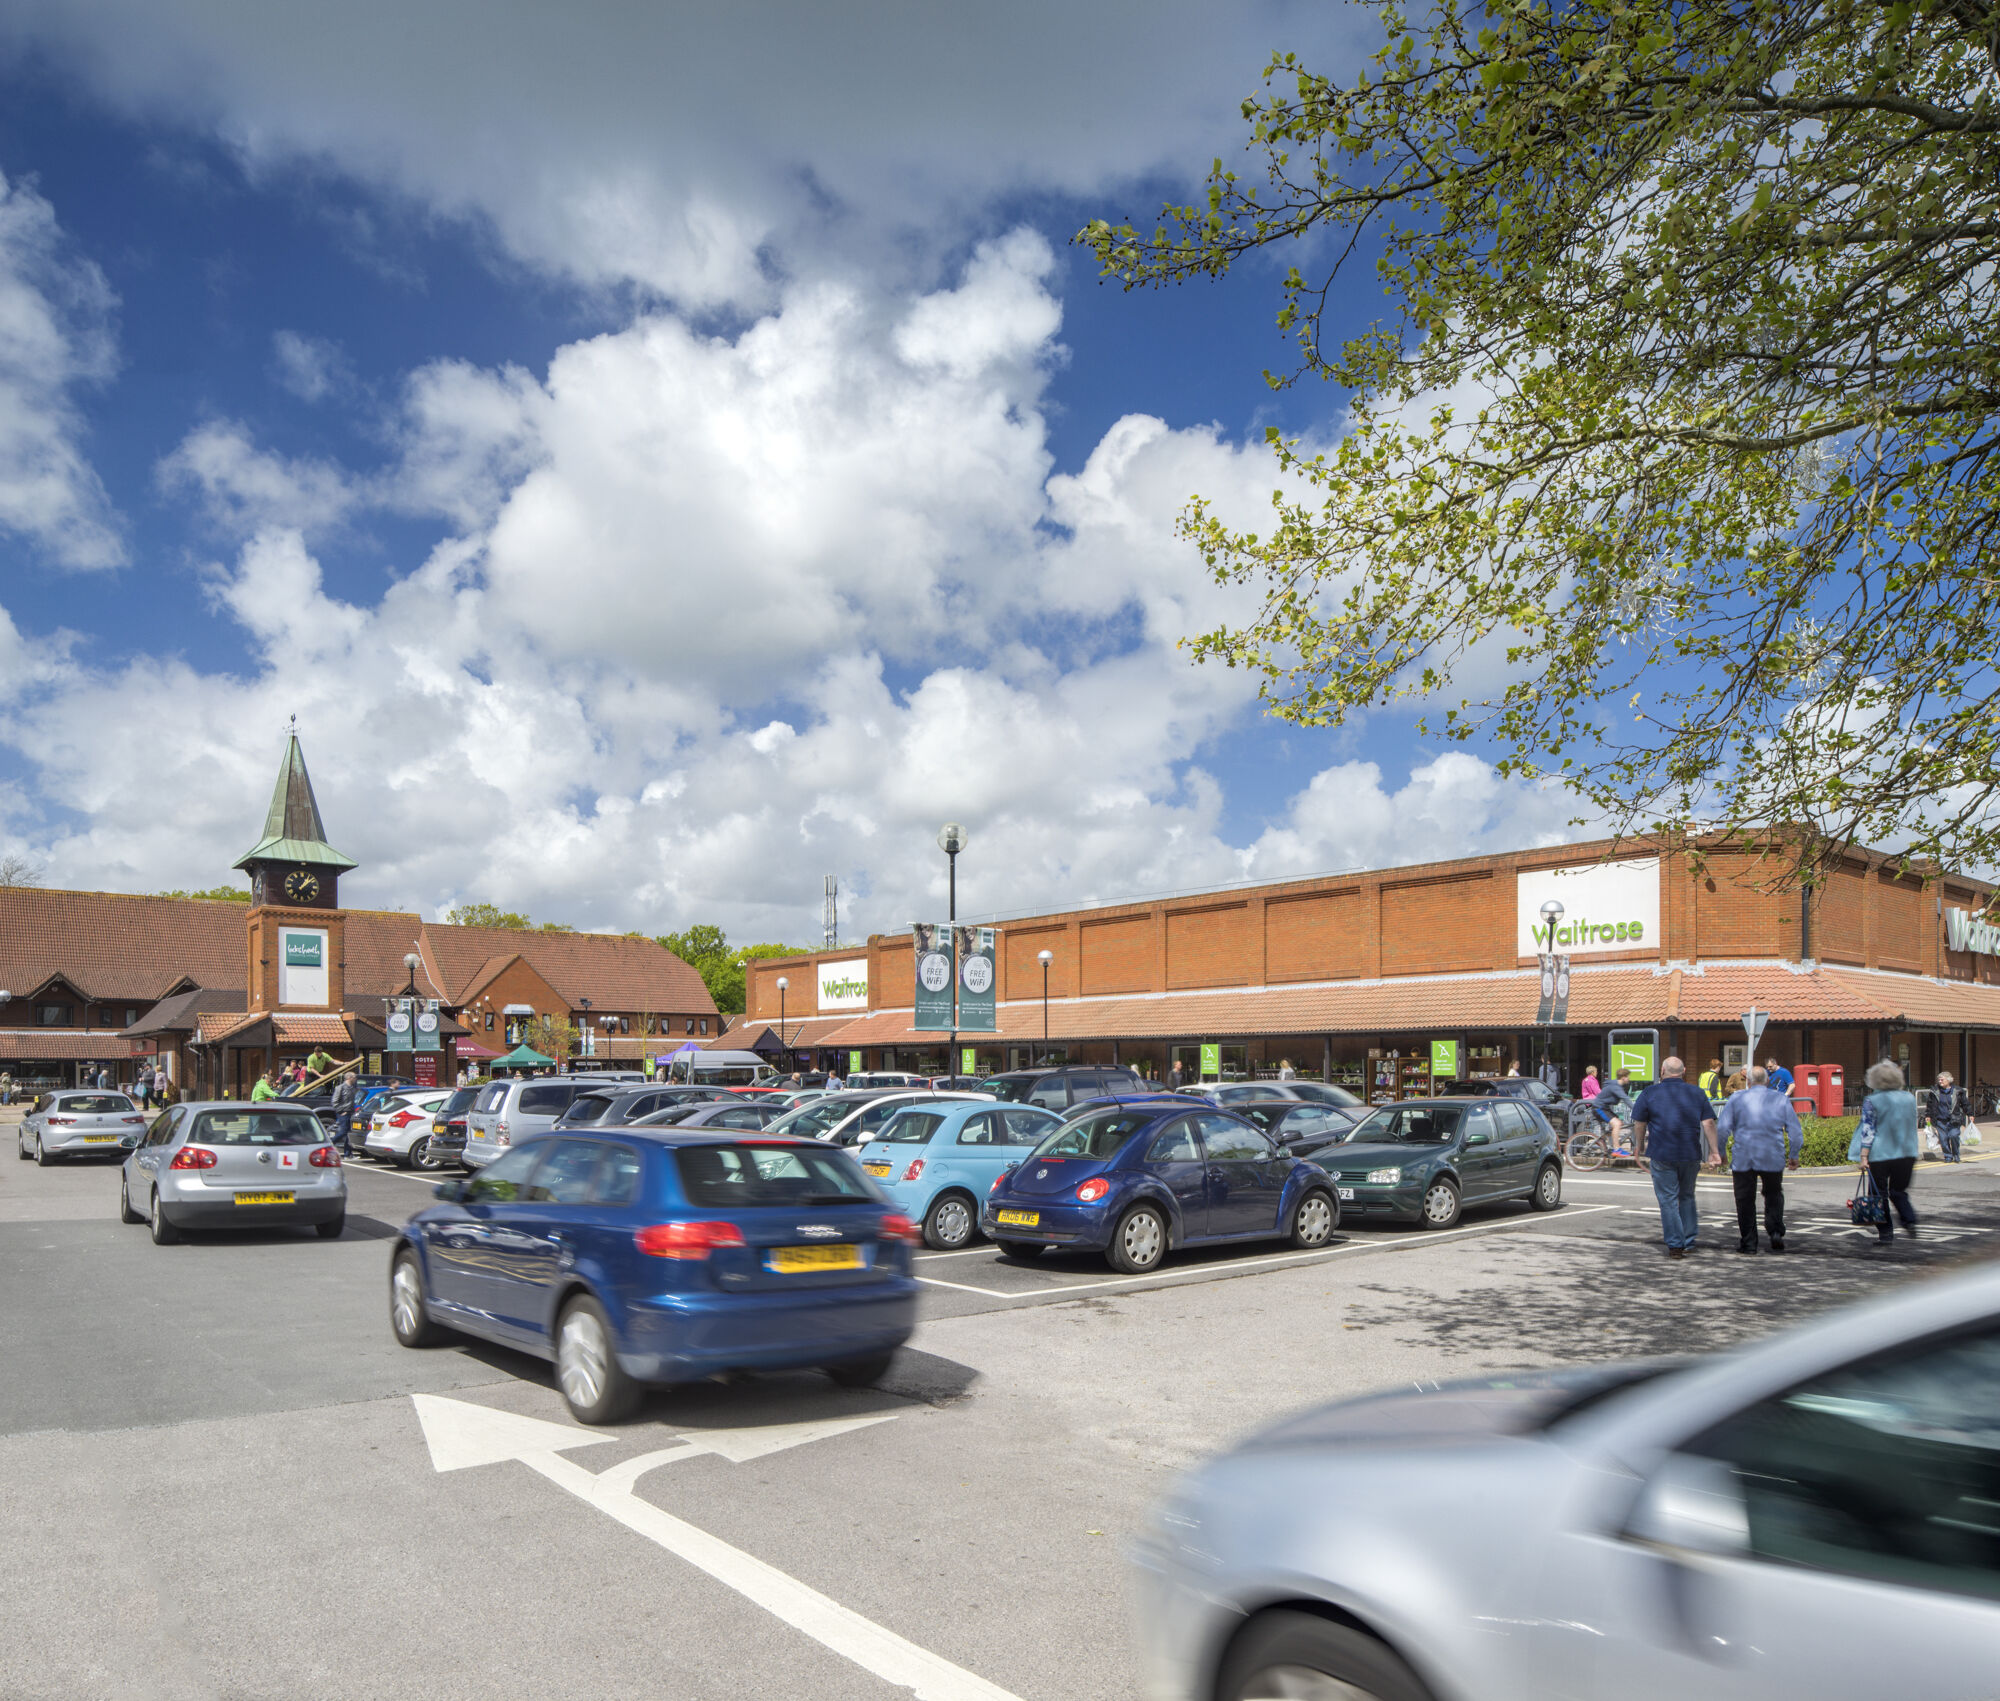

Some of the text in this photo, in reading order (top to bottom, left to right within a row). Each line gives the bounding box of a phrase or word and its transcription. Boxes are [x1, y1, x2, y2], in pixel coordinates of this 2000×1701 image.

[1531, 918, 1644, 948] Waitrose
[926, 967, 944, 976] FREE
[969, 969, 986, 978] FREE
[926, 976, 942, 985] WiFi
[969, 978, 985, 987] WiFi
[283, 1155, 293, 1166] L
